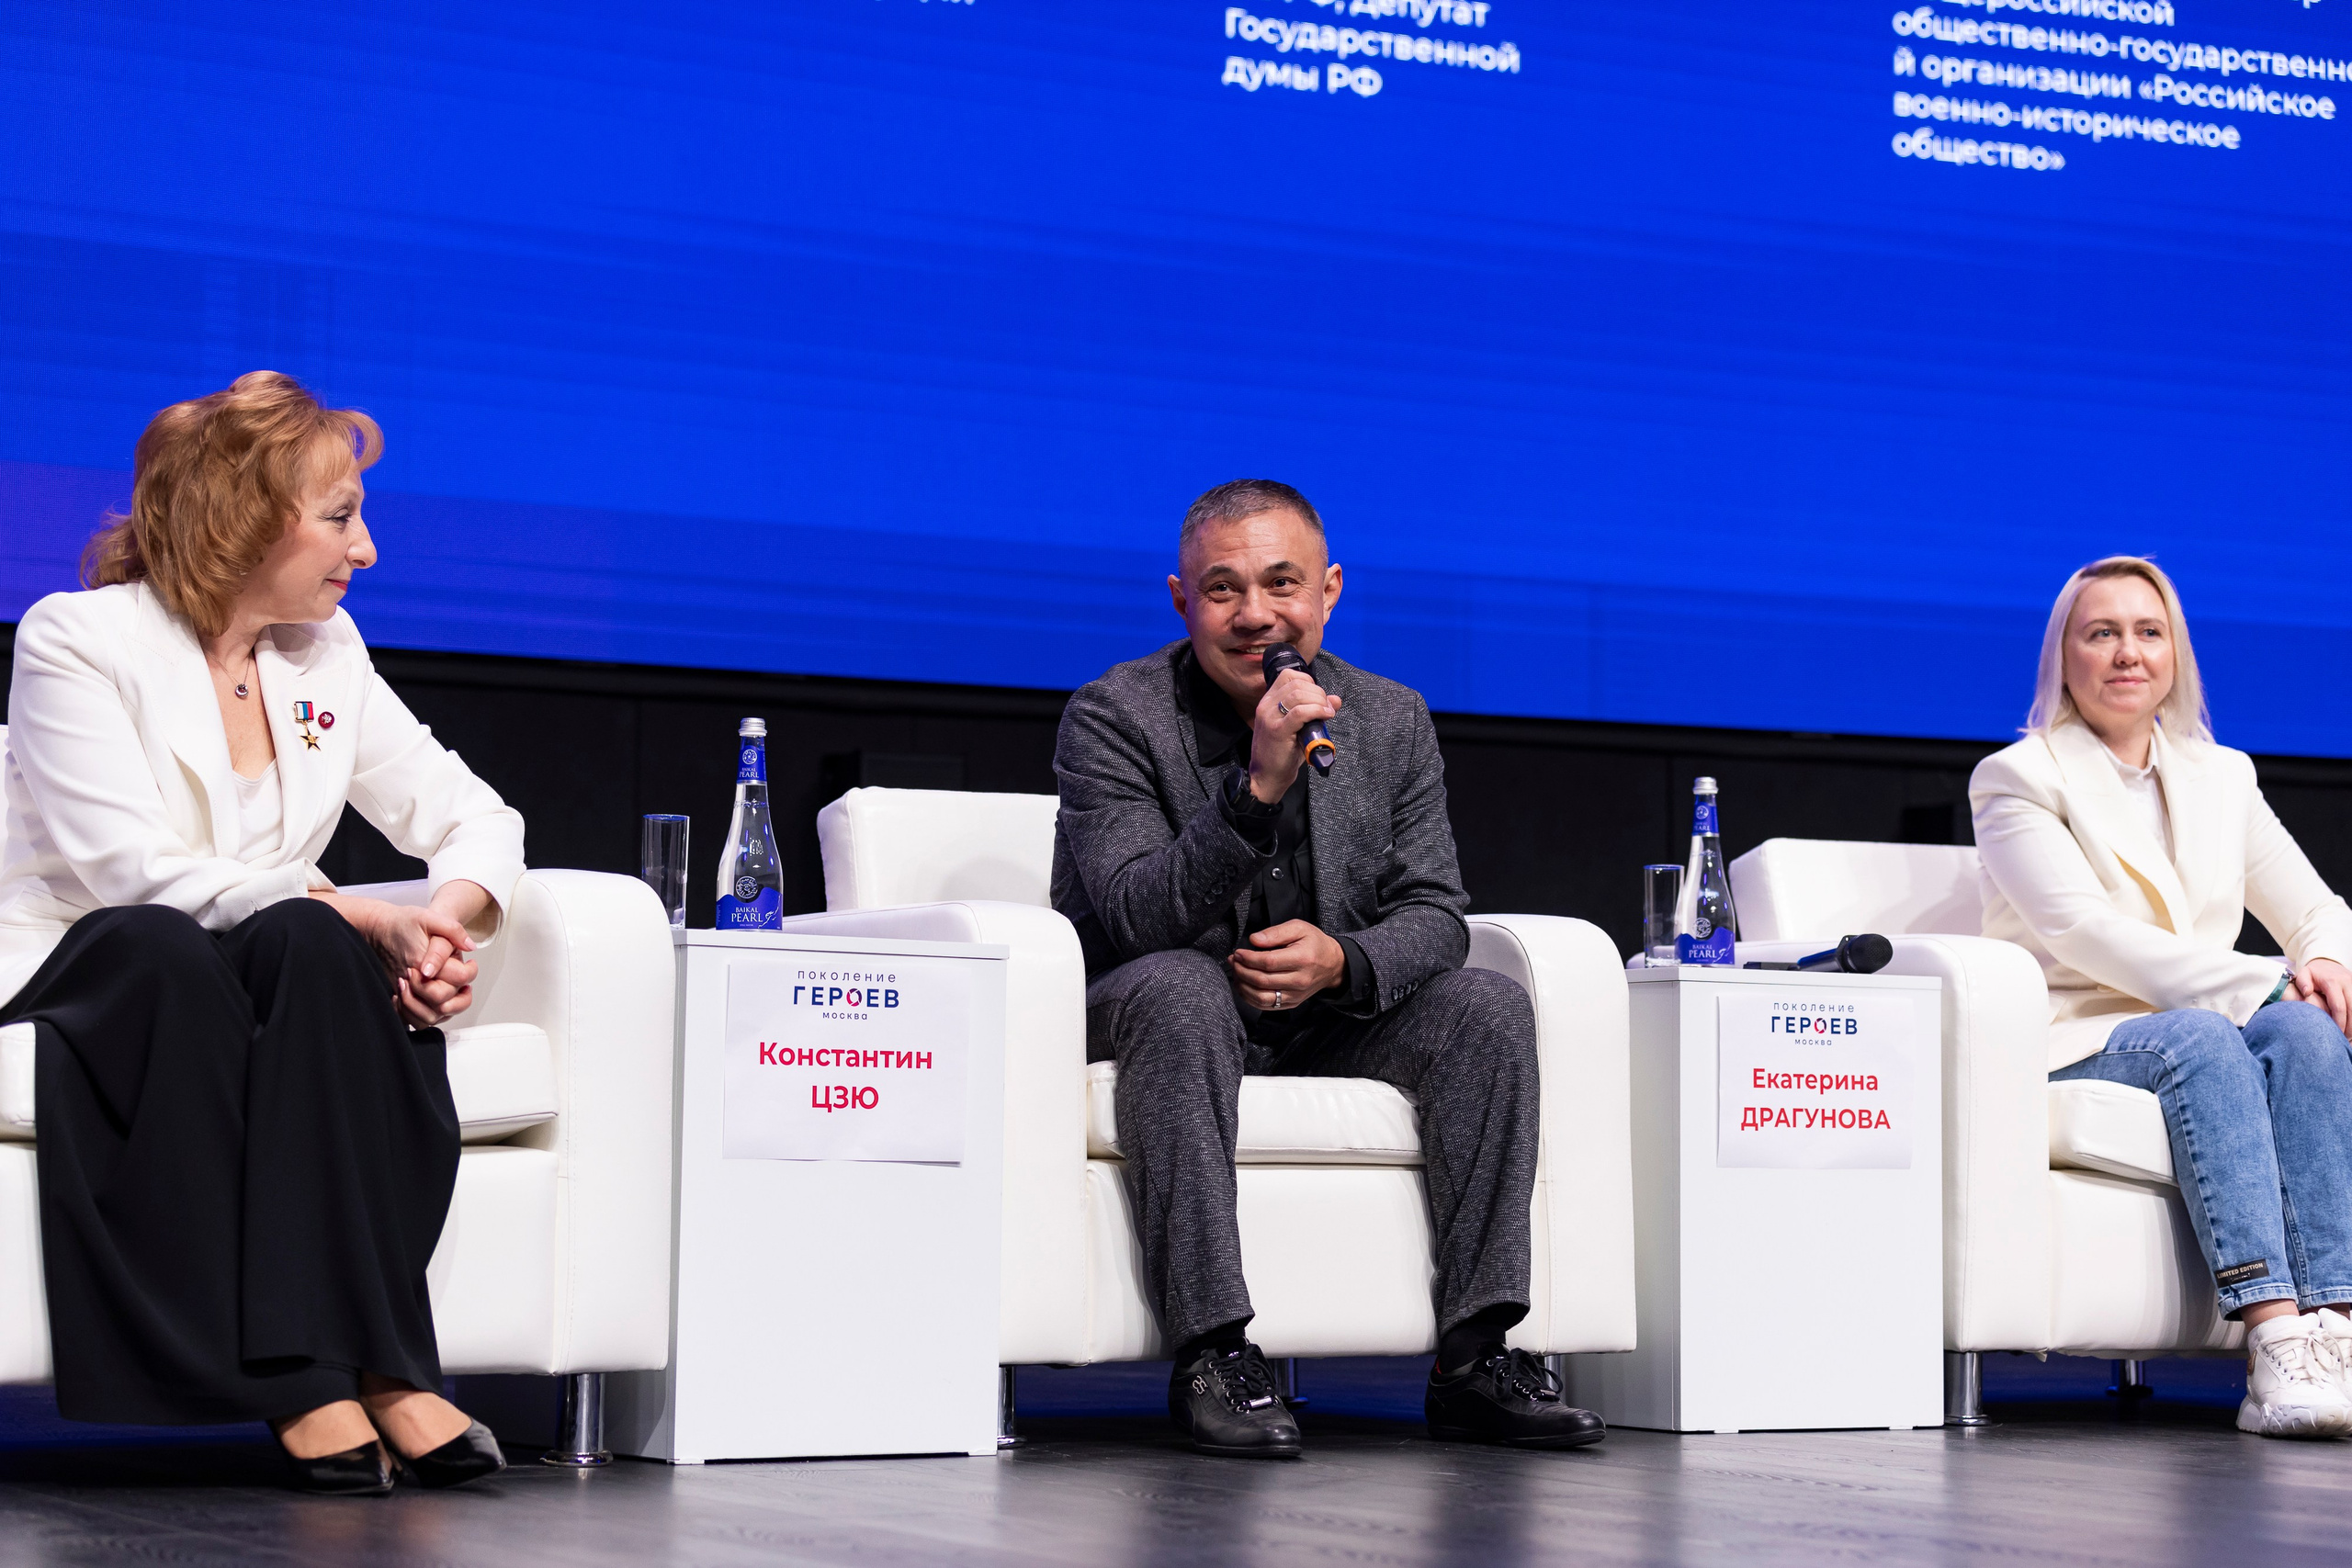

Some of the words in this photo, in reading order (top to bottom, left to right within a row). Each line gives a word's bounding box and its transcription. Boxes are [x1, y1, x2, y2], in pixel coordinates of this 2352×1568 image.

[1225, 6, 1521, 73] Государственной
[1221, 55, 1319, 93] думы
[1327, 62, 1384, 97] РФ
[1894, 46, 1917, 76] й
[1920, 54, 2132, 99] организации
[2138, 73, 2336, 120] «Российское
[1893, 91, 2241, 150] военно-историческое
[1892, 127, 2066, 172] общество»
[731, 913, 763, 922] PEARL
[1689, 949, 1717, 958] PEARL
[797, 970, 896, 983] поколение
[793, 986, 899, 1009] ГЕРОЕВ
[1773, 1002, 1855, 1013] поколение
[822, 1011, 868, 1021] москва
[1771, 1016, 1858, 1035] ГЕРОЕВ
[759, 1042, 933, 1069] Константин
[1753, 1067, 1879, 1095] Екатерина
[811, 1085, 879, 1113] ЦЗЮ
[1740, 1106, 1892, 1132] ДРАГУНОВА
[2217, 1269, 2239, 1279] LIMITED
[2240, 1262, 2263, 1272] EDITION
